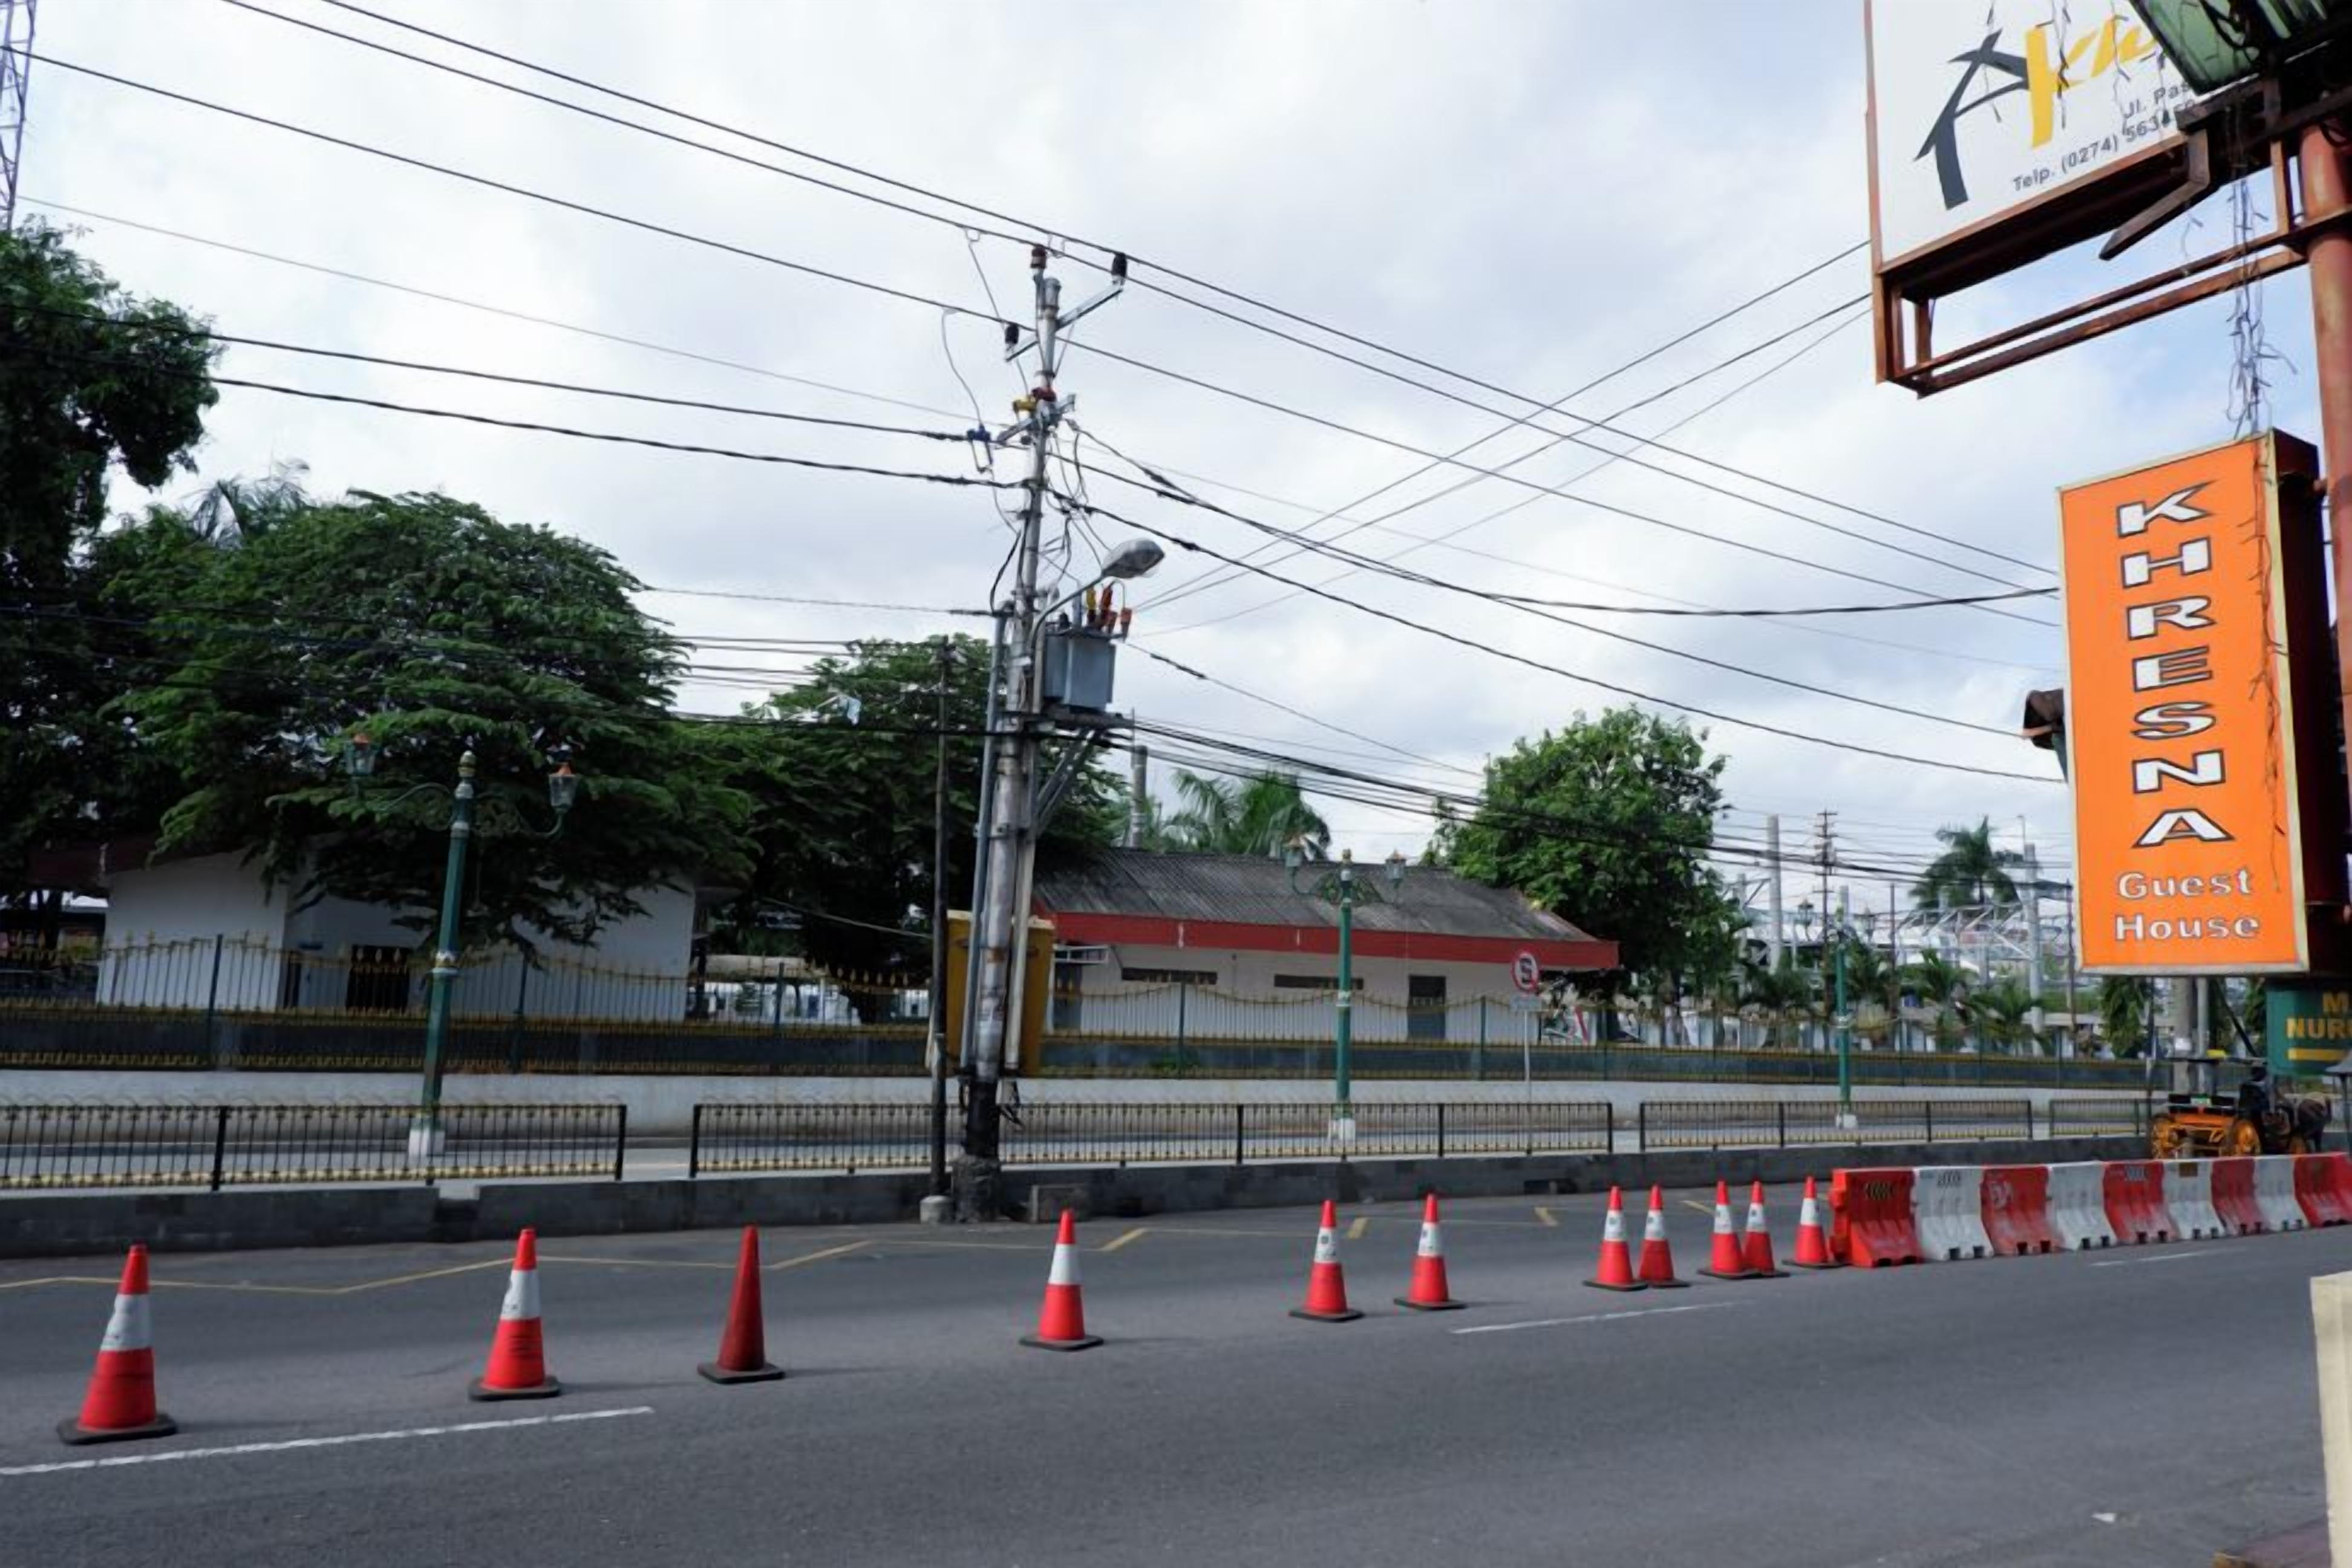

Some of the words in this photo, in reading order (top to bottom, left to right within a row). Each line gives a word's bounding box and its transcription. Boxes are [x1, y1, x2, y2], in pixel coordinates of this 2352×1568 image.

[2154, 80, 2190, 105] Pas
[2013, 168, 2055, 192] Telp.
[2062, 133, 2118, 174] (0274)
[2117, 480, 2235, 848] KHRESNA
[2117, 864, 2252, 900] Guest
[2115, 912, 2259, 941] House
[2322, 991, 2352, 1013] M
